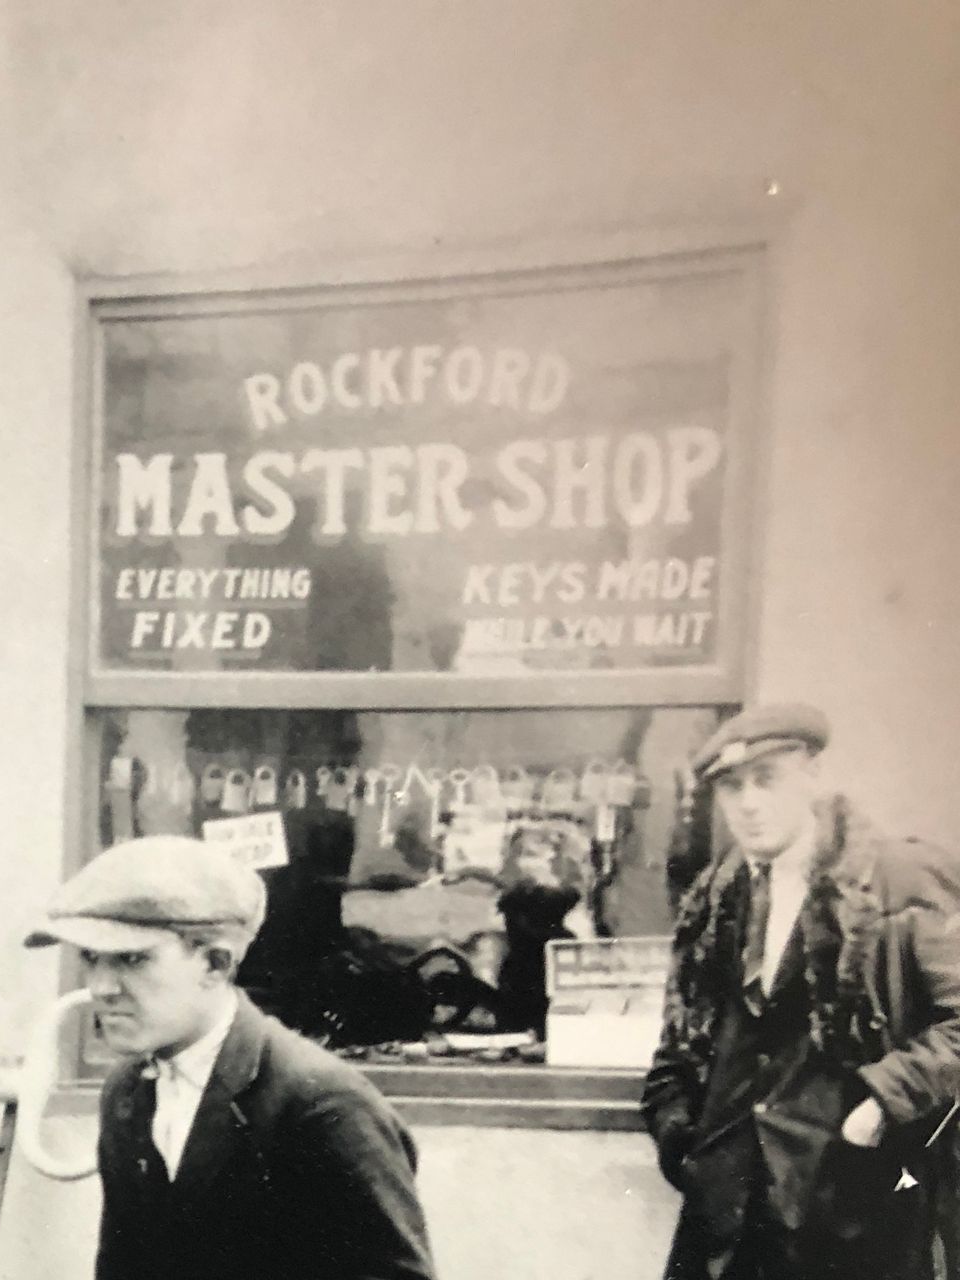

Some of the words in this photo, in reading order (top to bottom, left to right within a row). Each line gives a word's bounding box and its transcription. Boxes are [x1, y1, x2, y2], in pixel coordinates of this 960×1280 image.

[244, 343, 569, 431] ROCKFORD
[115, 444, 472, 536] MASTER
[493, 427, 721, 529] SHOP
[116, 567, 311, 600] EVERYTHING
[462, 562, 586, 606] KEYS
[597, 555, 716, 600] MADE
[131, 611, 271, 649] FIXED
[559, 614, 623, 649] YOU
